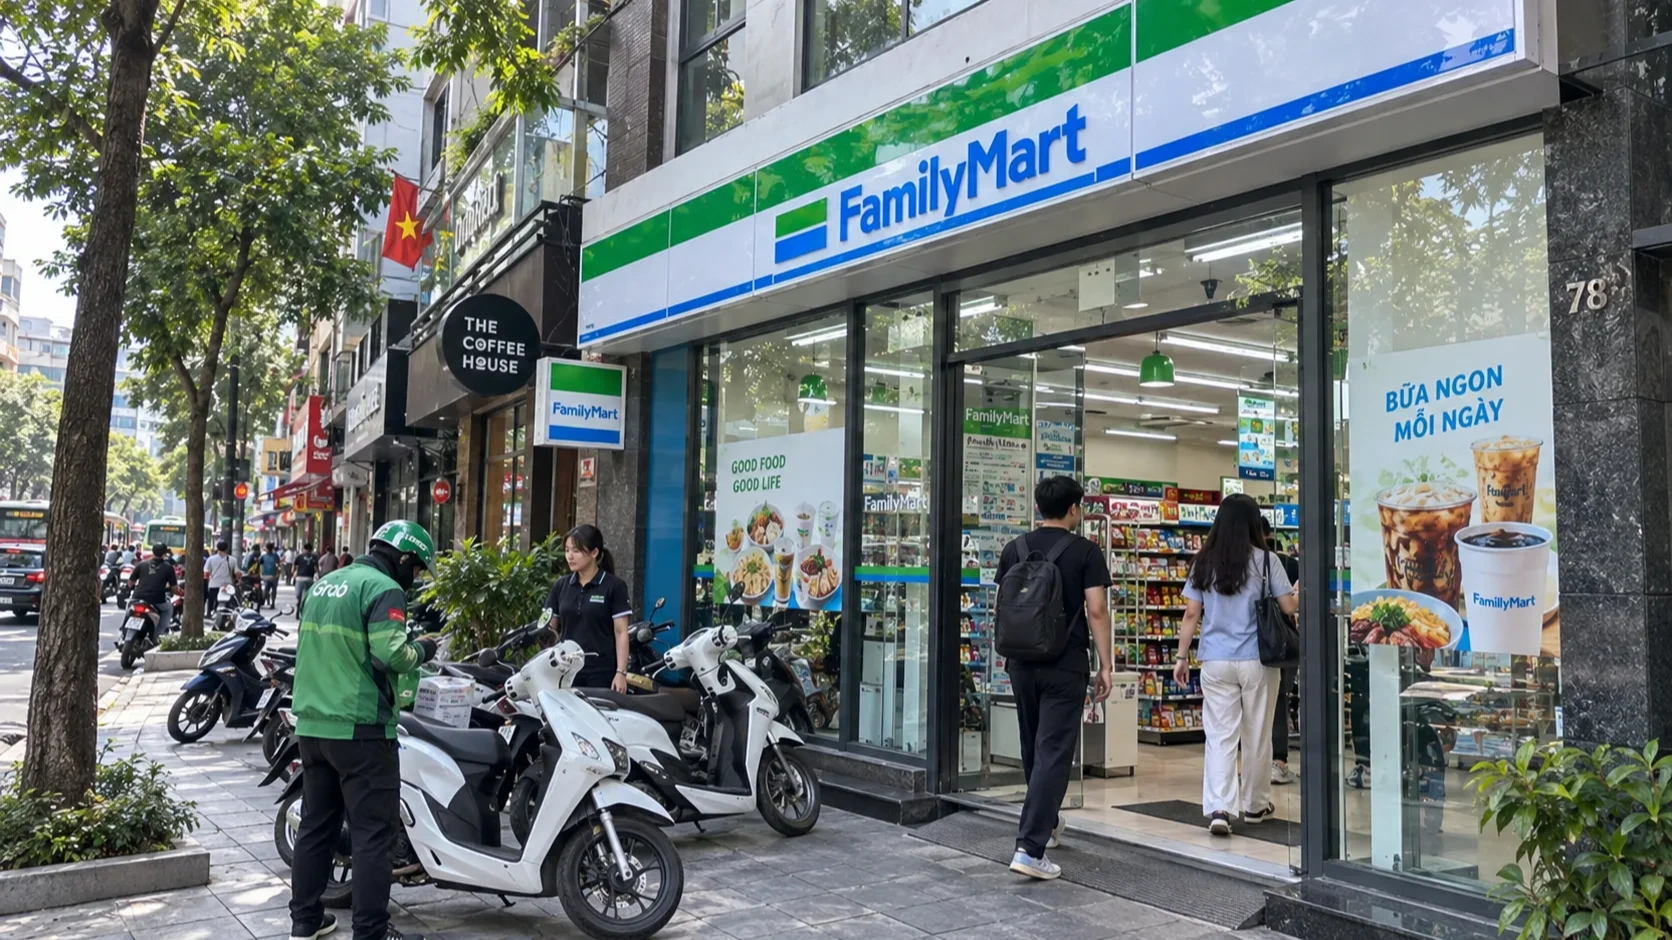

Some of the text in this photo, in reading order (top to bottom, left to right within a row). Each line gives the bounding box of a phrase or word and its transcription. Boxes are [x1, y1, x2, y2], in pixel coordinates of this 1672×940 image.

[839, 103, 1087, 242] FamilyMart
[1565, 278, 1608, 315] 78
[464, 316, 498, 334] THE
[462, 336, 526, 357] COFFEE
[462, 354, 519, 374] HOUSE
[1386, 364, 1503, 413] BỮA NGON
[552, 401, 619, 420] FamilyMart
[965, 407, 1030, 426] FamilyMart
[1394, 397, 1504, 443] MỖI NGÀY
[731, 454, 786, 474] GOOD FOOD
[733, 474, 781, 493] GOOD LIFE
[864, 494, 928, 513] FamilyMart
[312, 580, 349, 598] Grab
